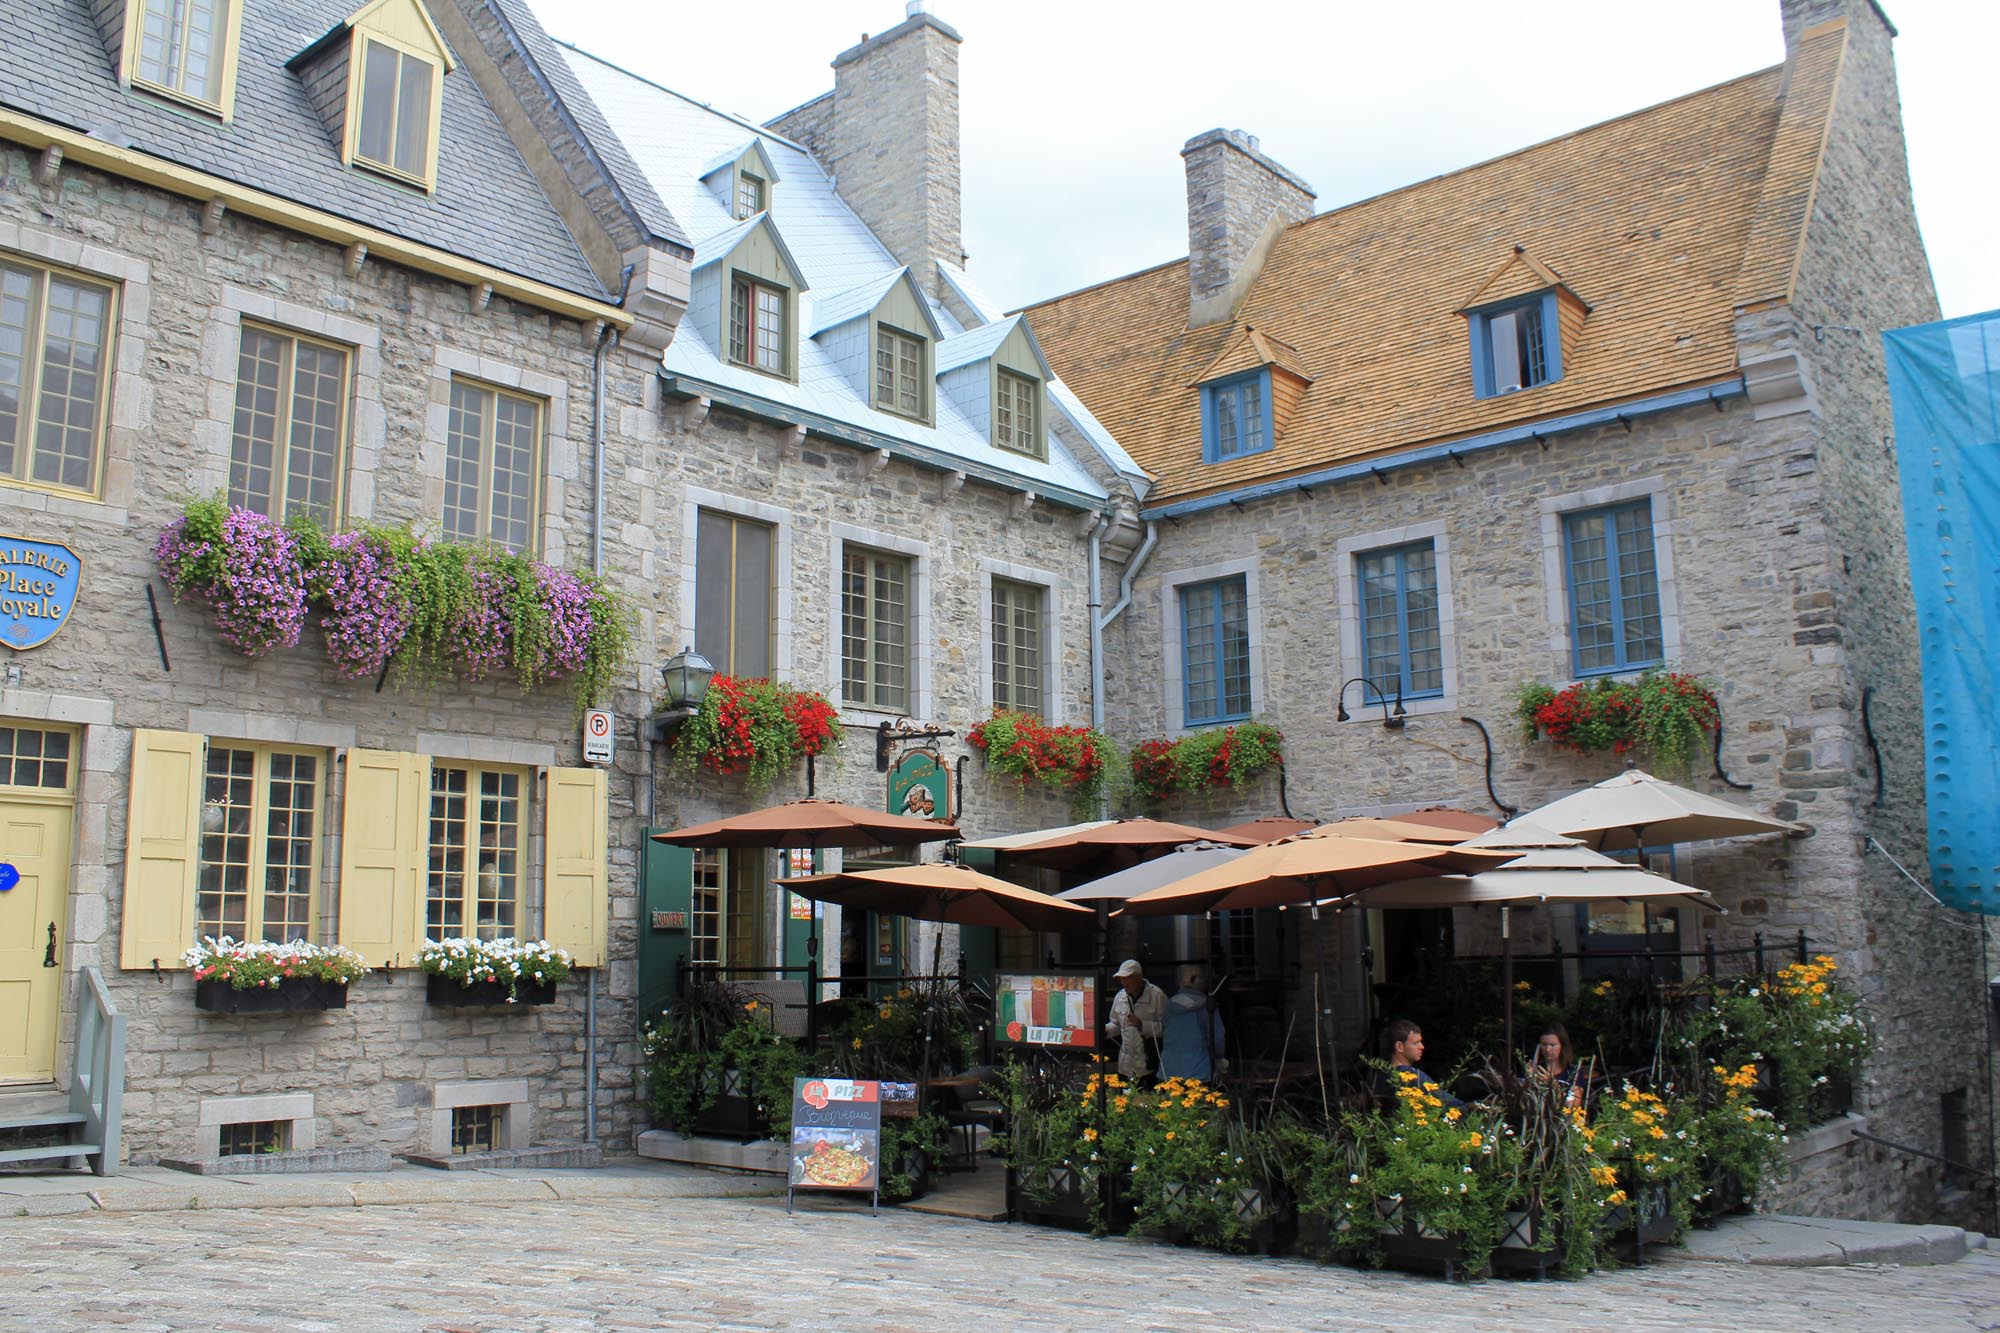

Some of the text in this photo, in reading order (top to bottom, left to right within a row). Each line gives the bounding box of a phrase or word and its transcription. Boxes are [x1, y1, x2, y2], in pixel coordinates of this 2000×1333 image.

[0, 548, 69, 577] ALERIE
[0, 569, 56, 596] Place
[0, 596, 61, 620] oyale
[656, 912, 685, 927] OUVERT
[1030, 1029, 1074, 1043] LA PIZZ
[834, 1085, 865, 1098] PIZZ
